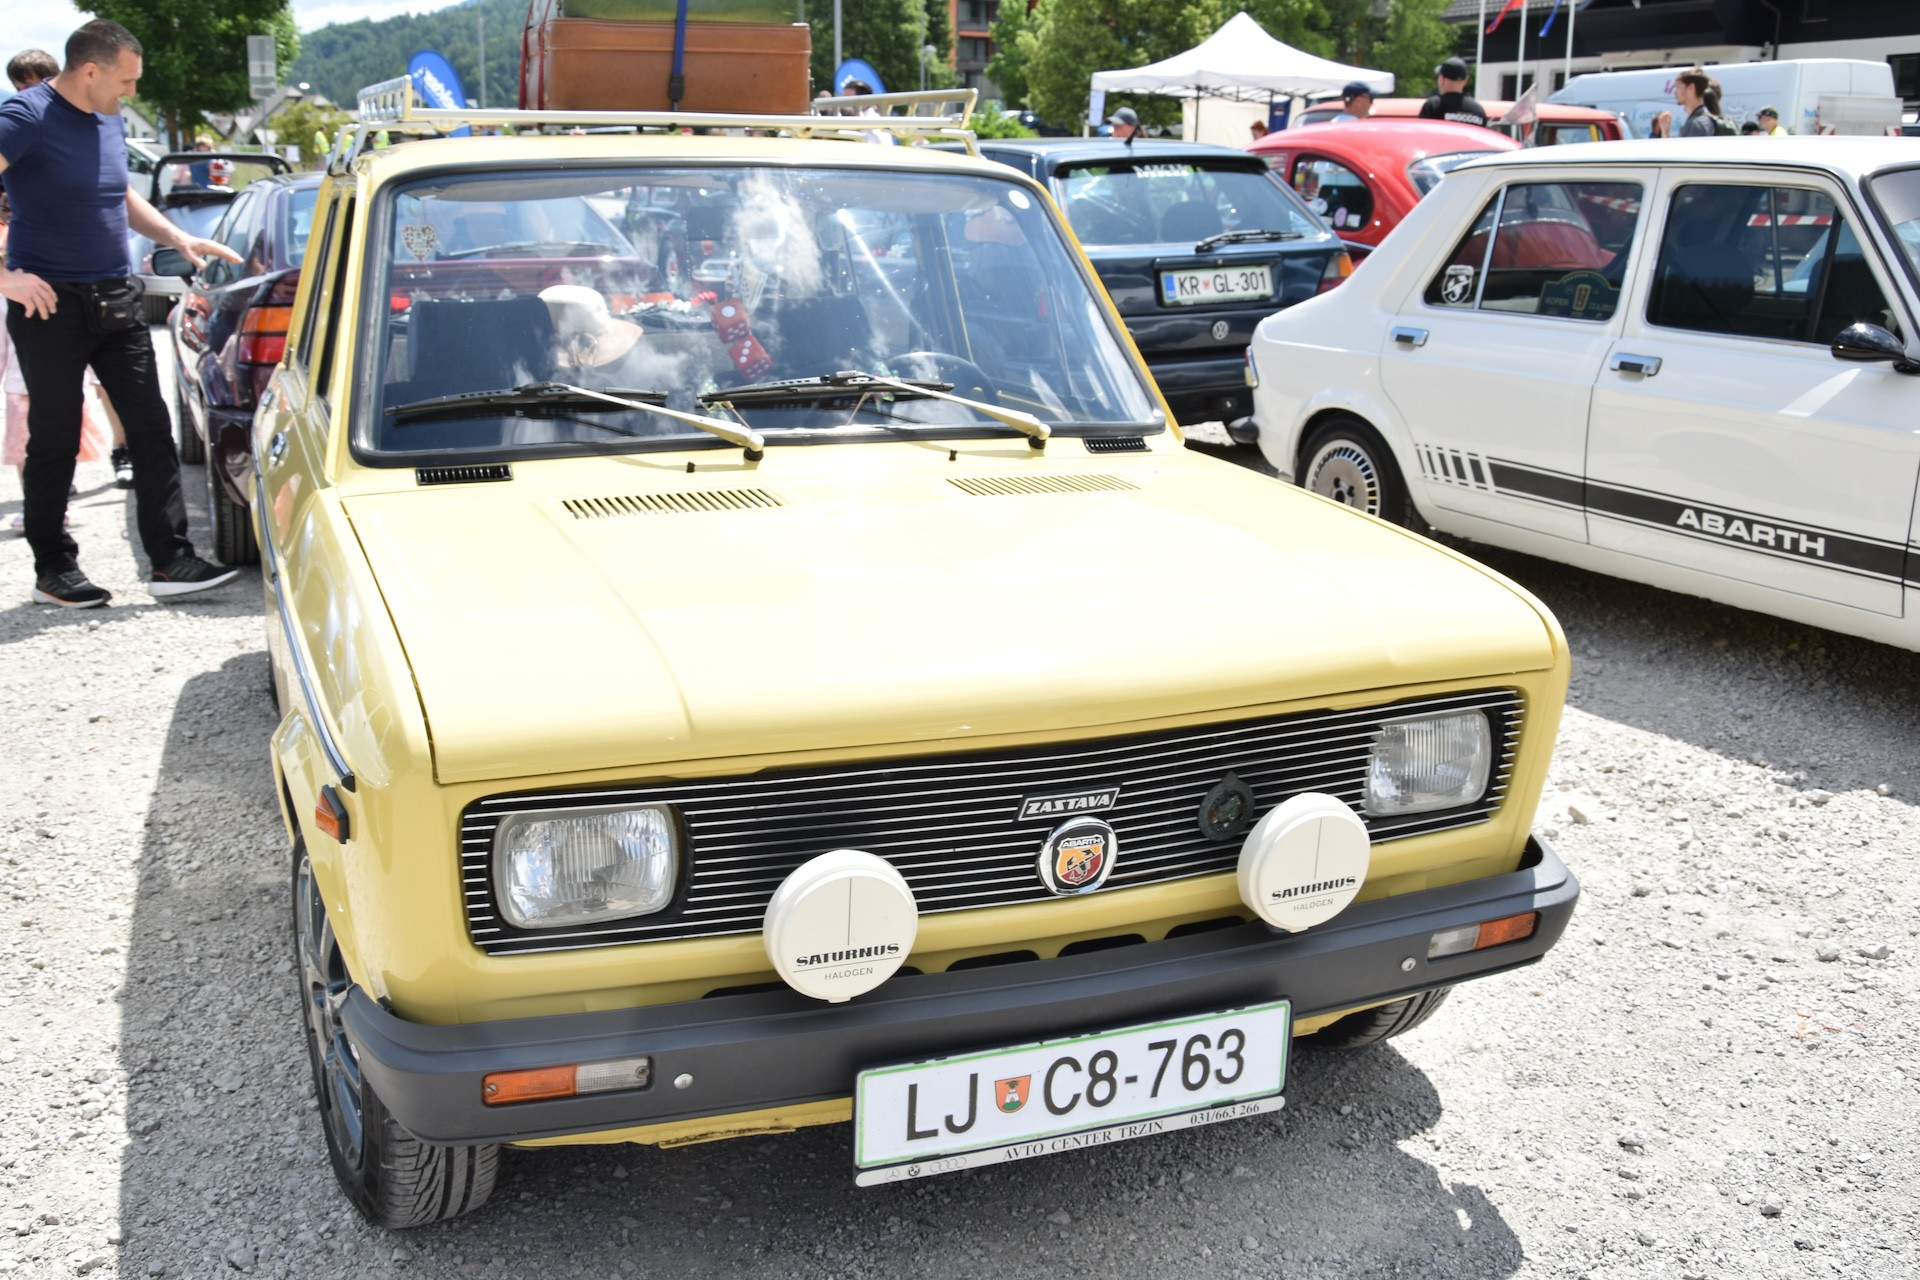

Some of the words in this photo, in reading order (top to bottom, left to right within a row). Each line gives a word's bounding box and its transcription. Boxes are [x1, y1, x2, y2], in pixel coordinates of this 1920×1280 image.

[1178, 276, 1200, 295] KR
[1213, 272, 1266, 293] GL-301
[1676, 508, 1826, 557] ABARTH
[1026, 794, 1110, 815] ZASTAVA
[1062, 838, 1101, 848] ABARTH
[1271, 875, 1356, 901] SATURNUS
[1293, 898, 1334, 912] HALOGEN
[796, 943, 900, 967] SATURNUS
[824, 967, 874, 980] HALOGEN
[906, 1073, 979, 1141] LJ
[1043, 1028, 1246, 1116] C8-763
[1003, 1143, 1044, 1160] AVTO
[1051, 1130, 1112, 1151] CENTER
[1118, 1120, 1164, 1138] TRZIN
[1189, 1107, 1237, 1125] 031/663
[1239, 1103, 1260, 1117] 266
